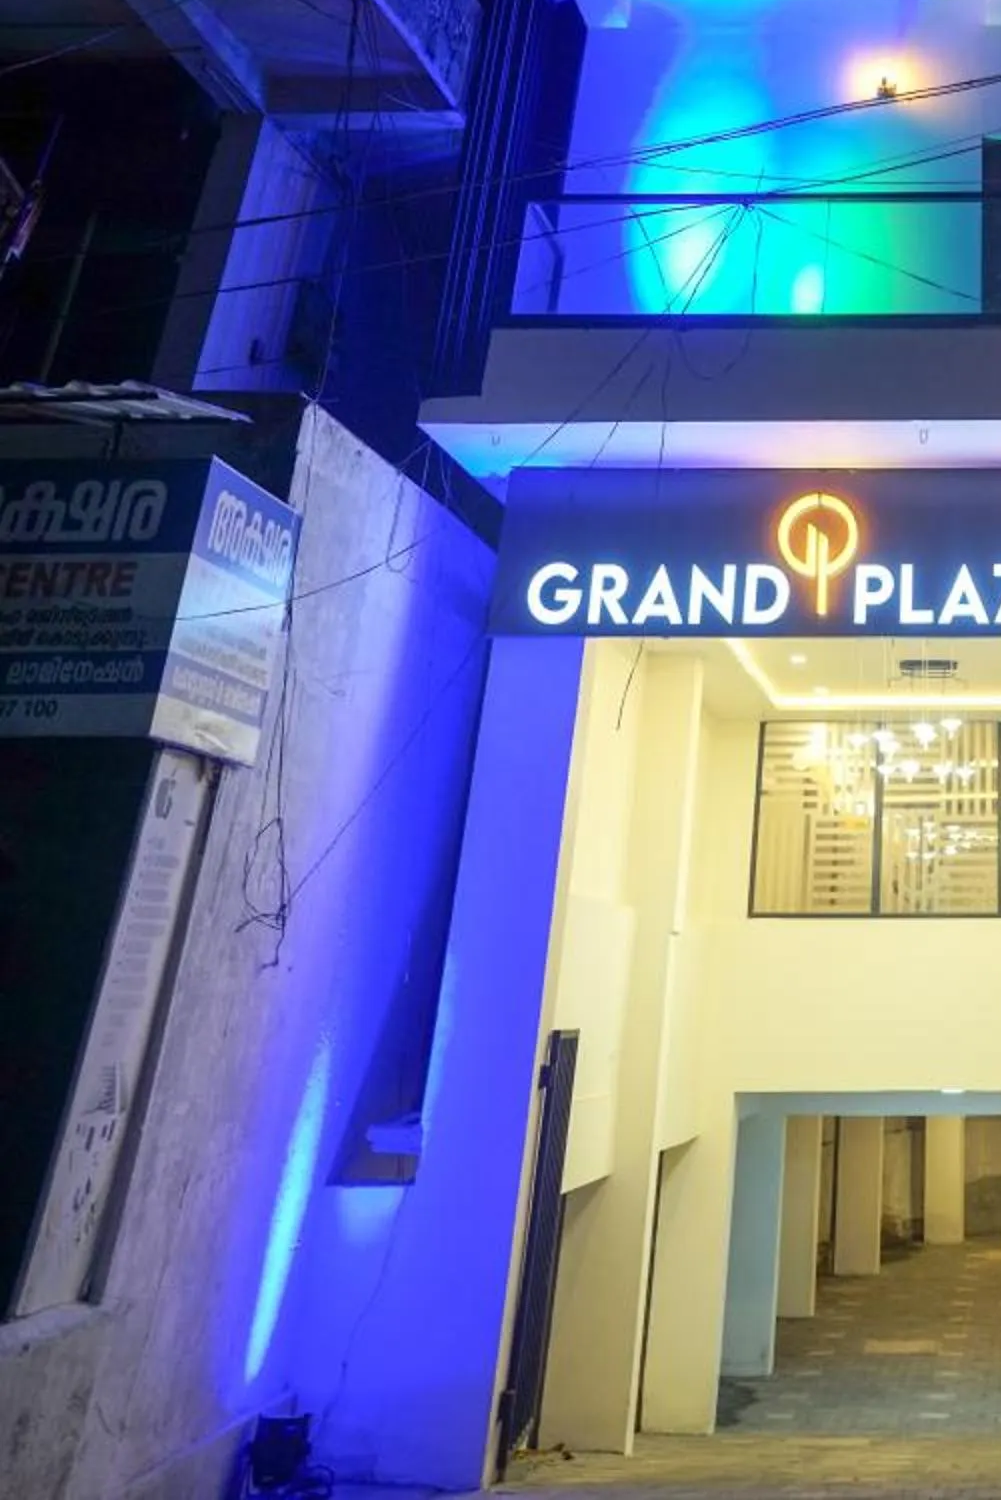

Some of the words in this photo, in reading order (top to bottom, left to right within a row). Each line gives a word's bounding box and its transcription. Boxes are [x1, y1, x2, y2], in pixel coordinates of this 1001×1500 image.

[0, 480, 168, 542] ക്ഷര
[0, 562, 136, 598] ENTRE
[527, 562, 791, 626] GRAND
[24, 699, 59, 718] 100
